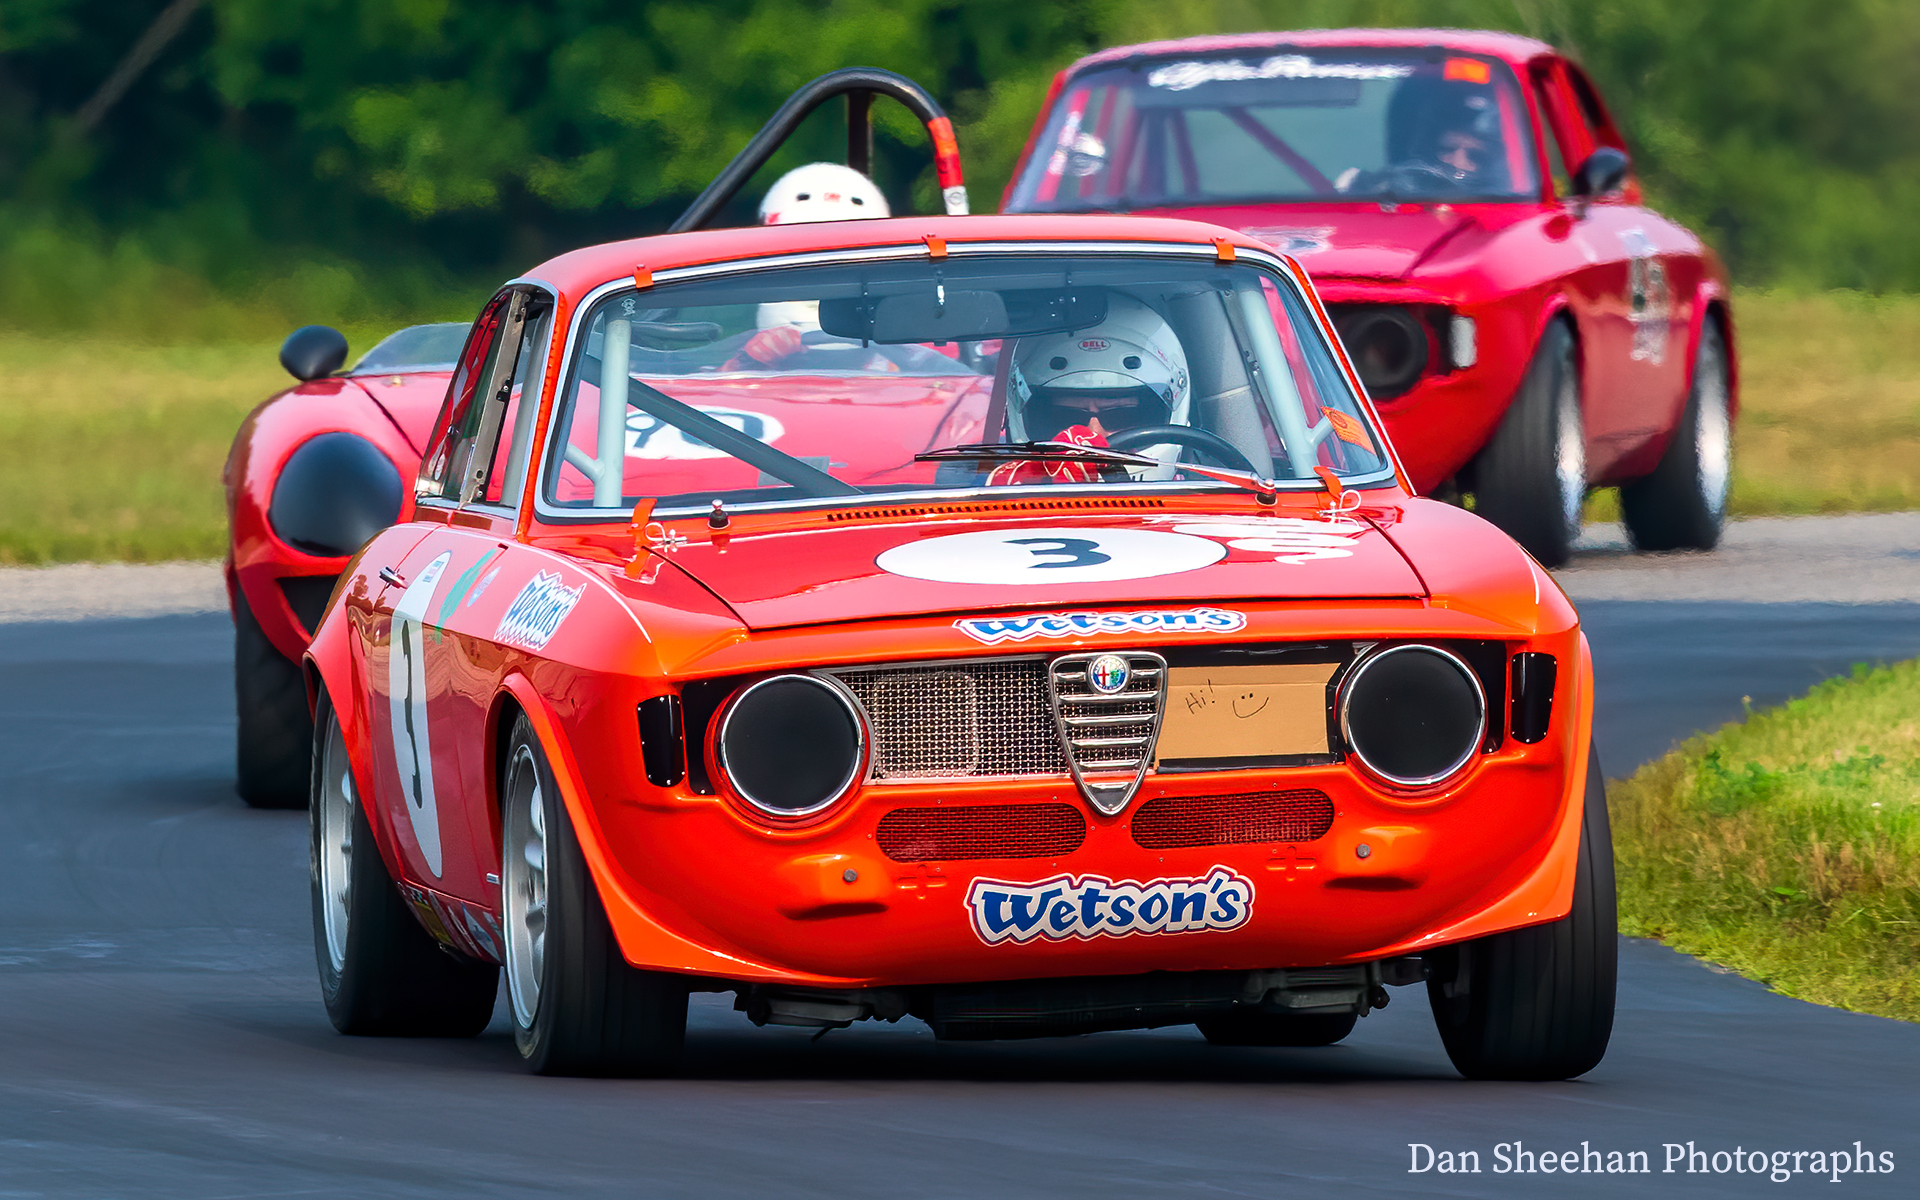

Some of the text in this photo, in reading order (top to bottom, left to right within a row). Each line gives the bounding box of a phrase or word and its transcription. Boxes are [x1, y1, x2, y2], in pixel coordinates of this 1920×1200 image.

[1081, 340, 1107, 348] BELL
[1003, 536, 1112, 569] 3
[969, 609, 1232, 636] Wetson's
[1184, 678, 1216, 715] Hi!
[981, 877, 1241, 935] Wetson's
